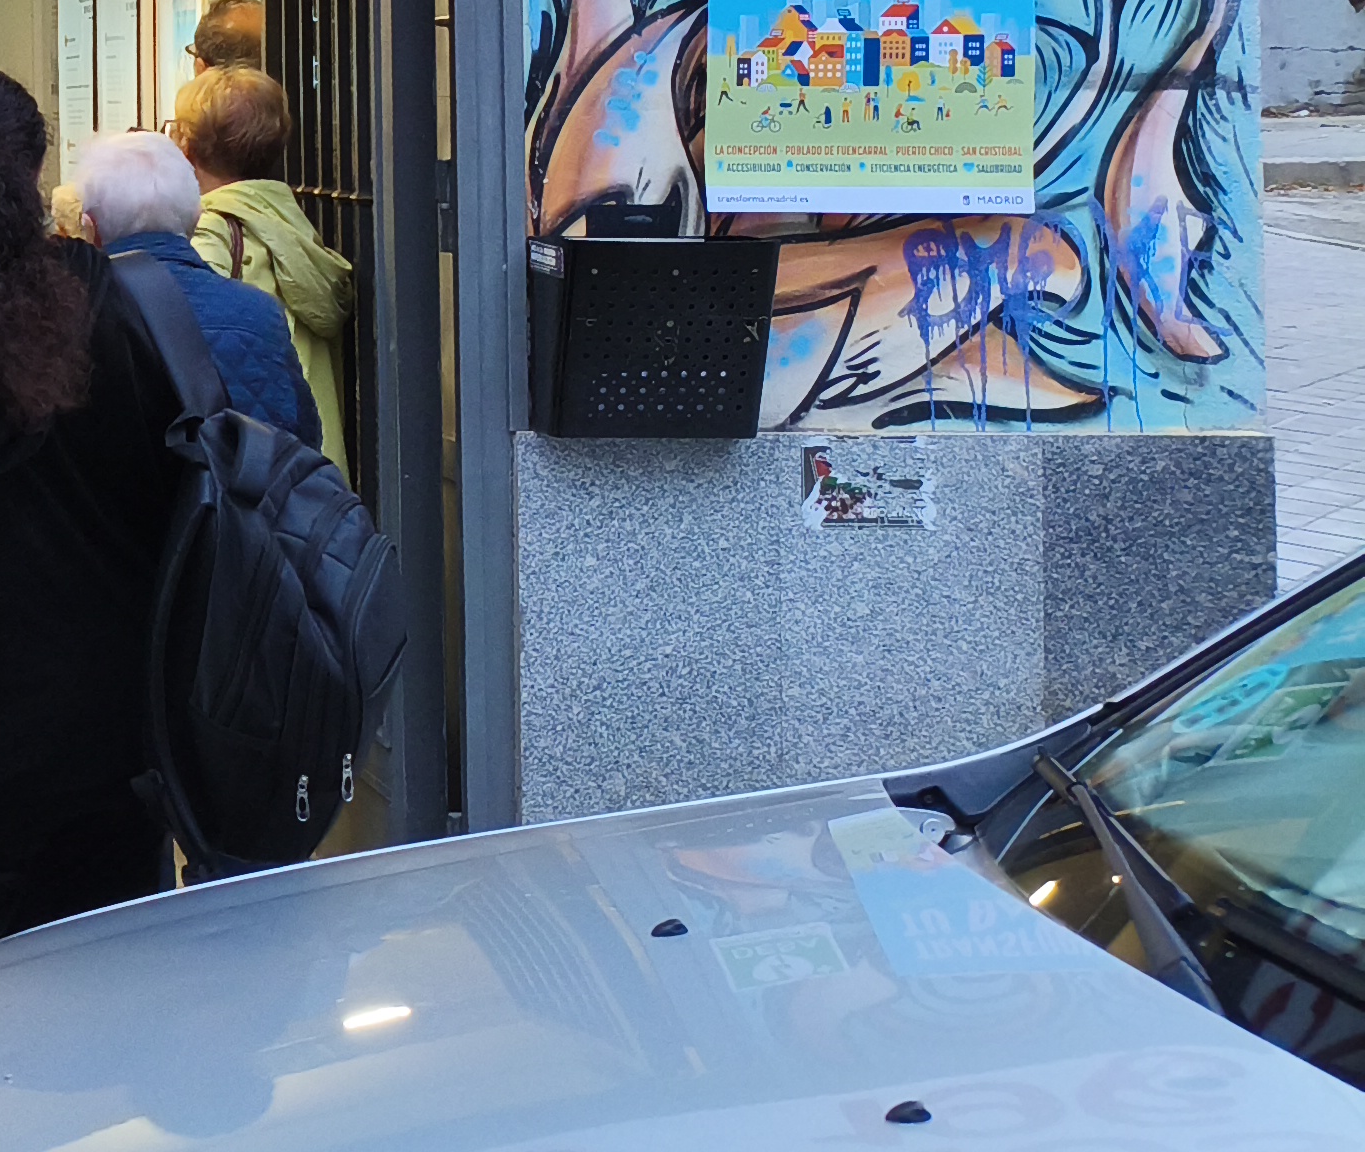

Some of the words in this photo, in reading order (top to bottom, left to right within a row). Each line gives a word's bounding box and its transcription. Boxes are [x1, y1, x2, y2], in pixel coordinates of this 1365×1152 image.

[715, 145, 724, 155] LA
[727, 142, 777, 155] CONCEPCIÓN
[786, 145, 822, 155] POBLADO
[825, 145, 834, 155] DE
[837, 145, 888, 156] FUENCARRAL
[896, 146, 926, 156] PUERTO
[929, 146, 953, 156] CHICO
[961, 146, 976, 156] SAN
[727, 163, 781, 172] ACCESIBILIDAD
[870, 164, 911, 173] EFICIENCIA
[978, 196, 1023, 204] MADRID
